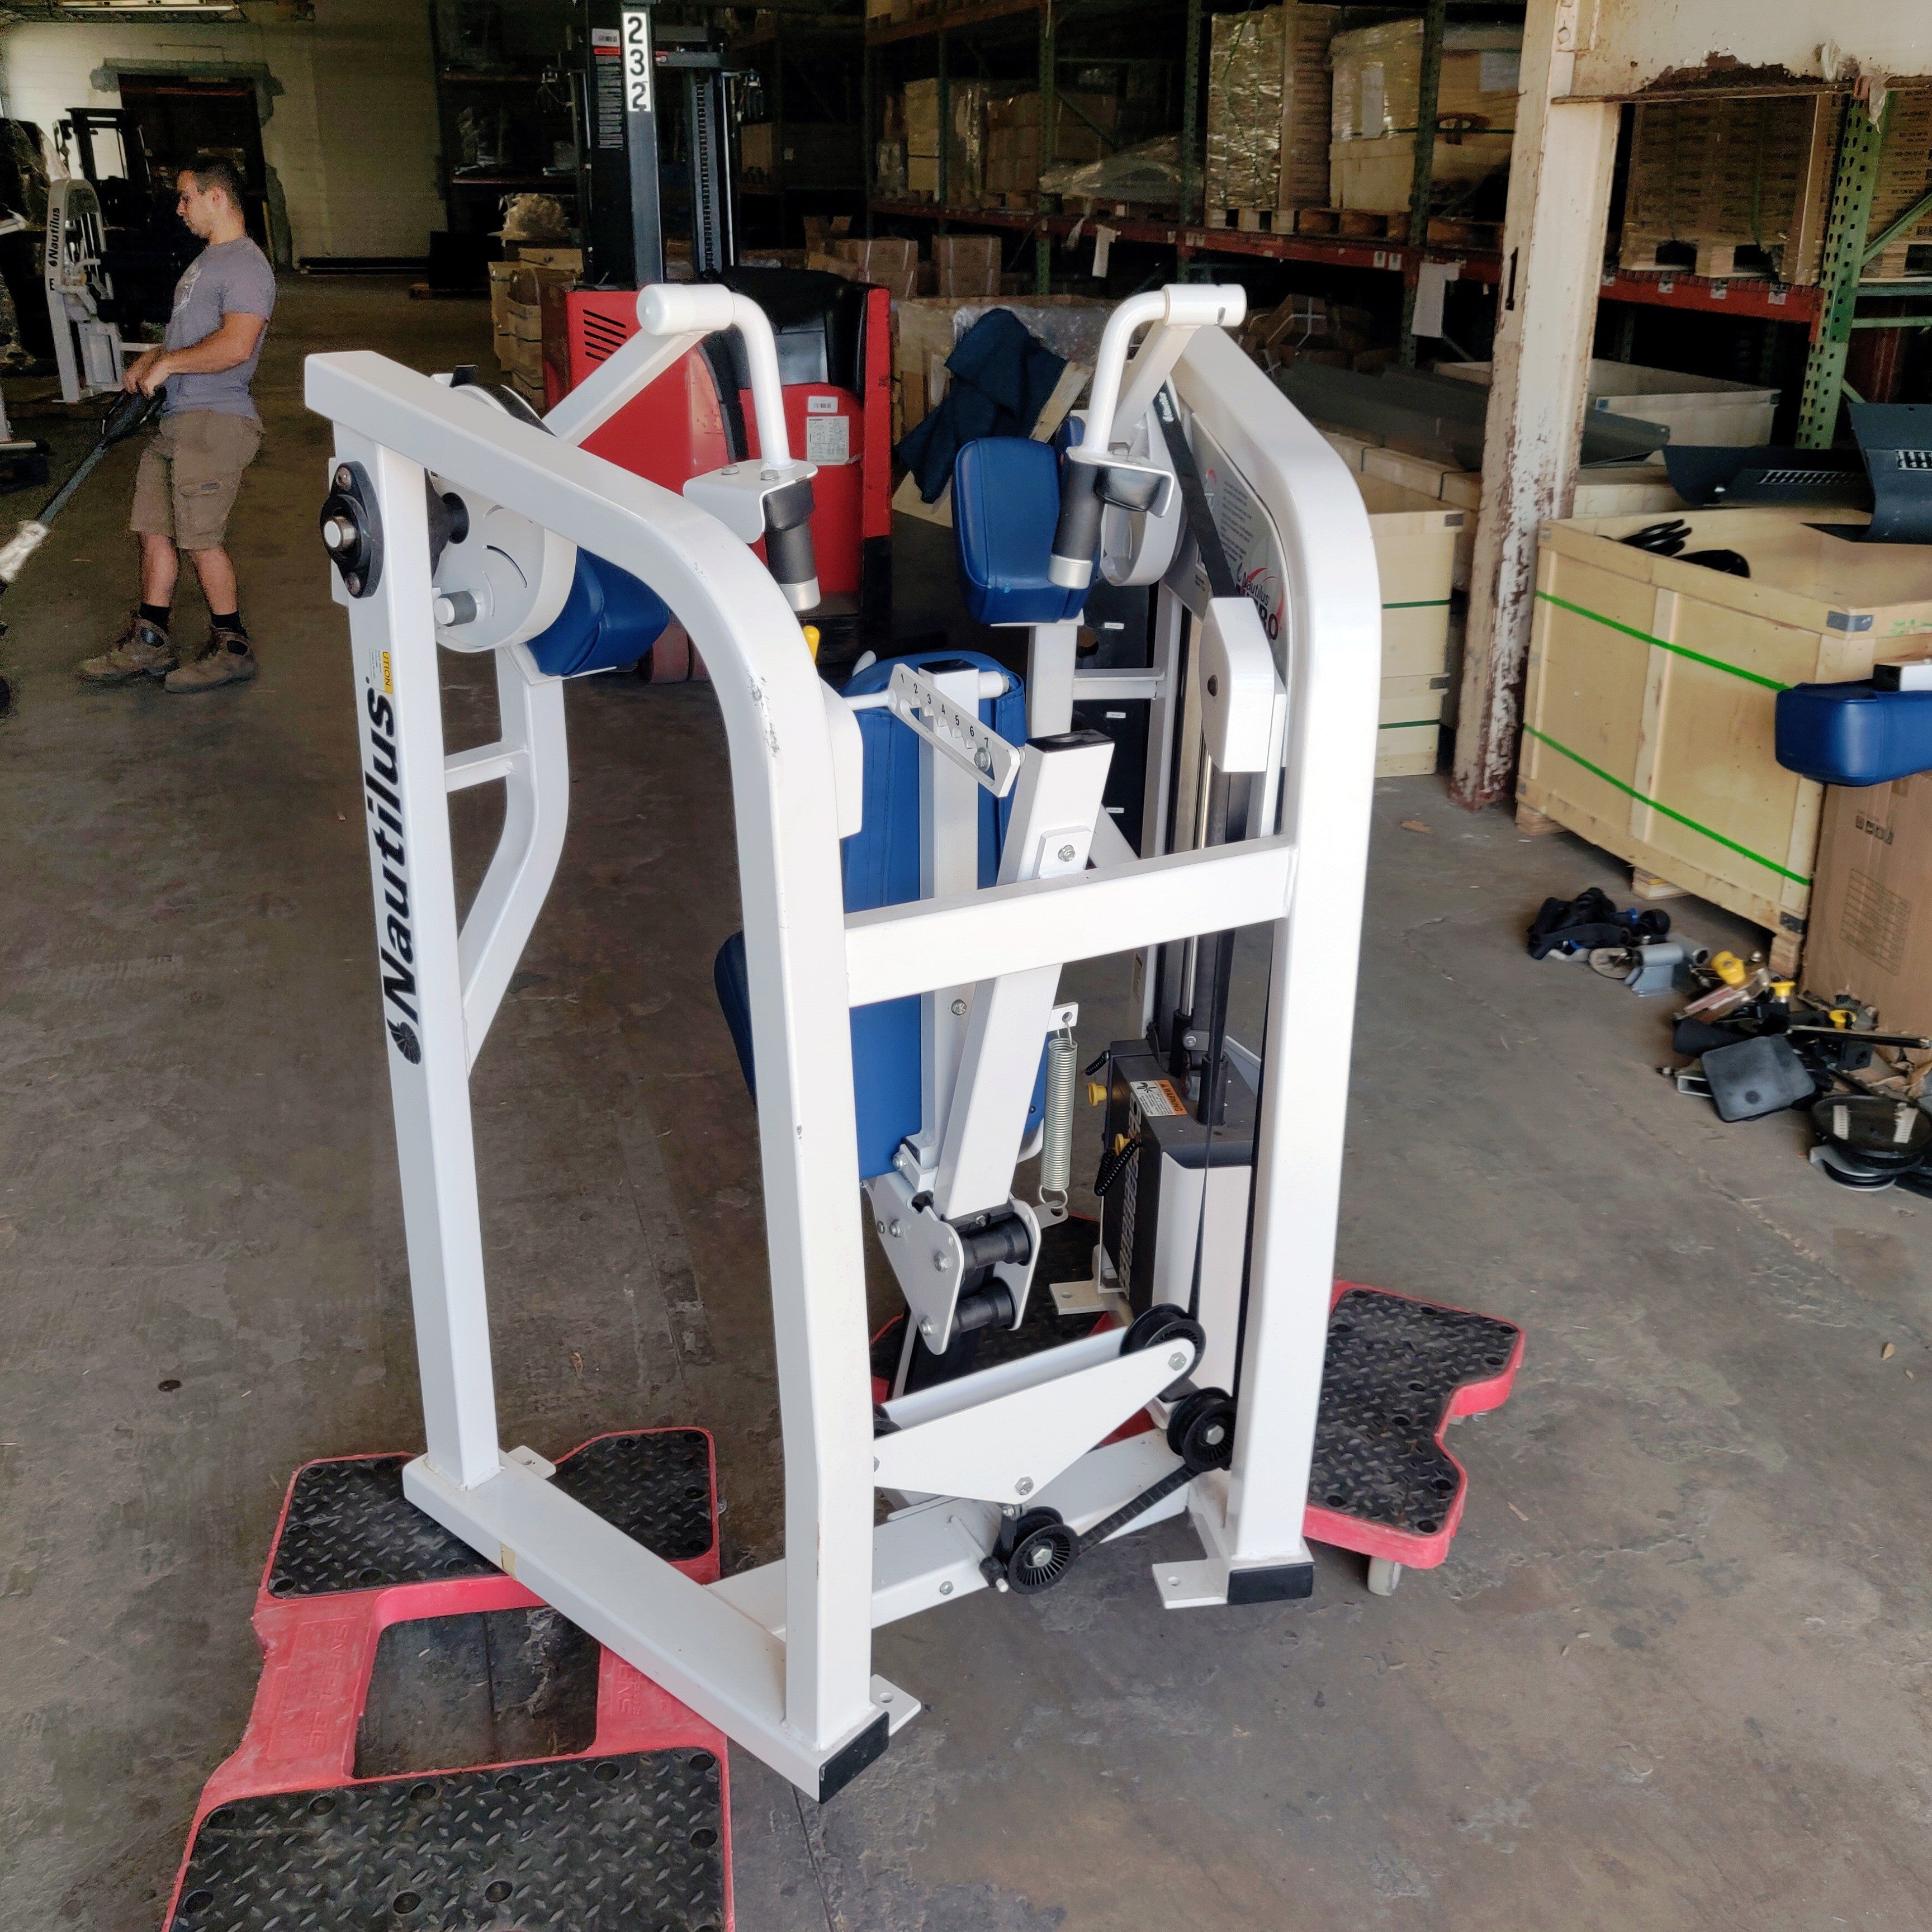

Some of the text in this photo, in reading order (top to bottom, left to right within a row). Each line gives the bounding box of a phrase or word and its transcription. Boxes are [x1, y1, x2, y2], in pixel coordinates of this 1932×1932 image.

[627, 16, 647, 111] 232
[48, 207, 60, 259] Nautilus
[1241, 572, 1270, 606] Nautilus
[901, 673, 905, 684] 1
[913, 683, 918, 694] 2
[927, 694, 931, 704] 3
[941, 704, 945, 715] 4
[955, 715, 960, 726] 5
[970, 726, 974, 737] 6
[984, 737, 988, 748] 7
[364, 687, 419, 1025] Nautilus
